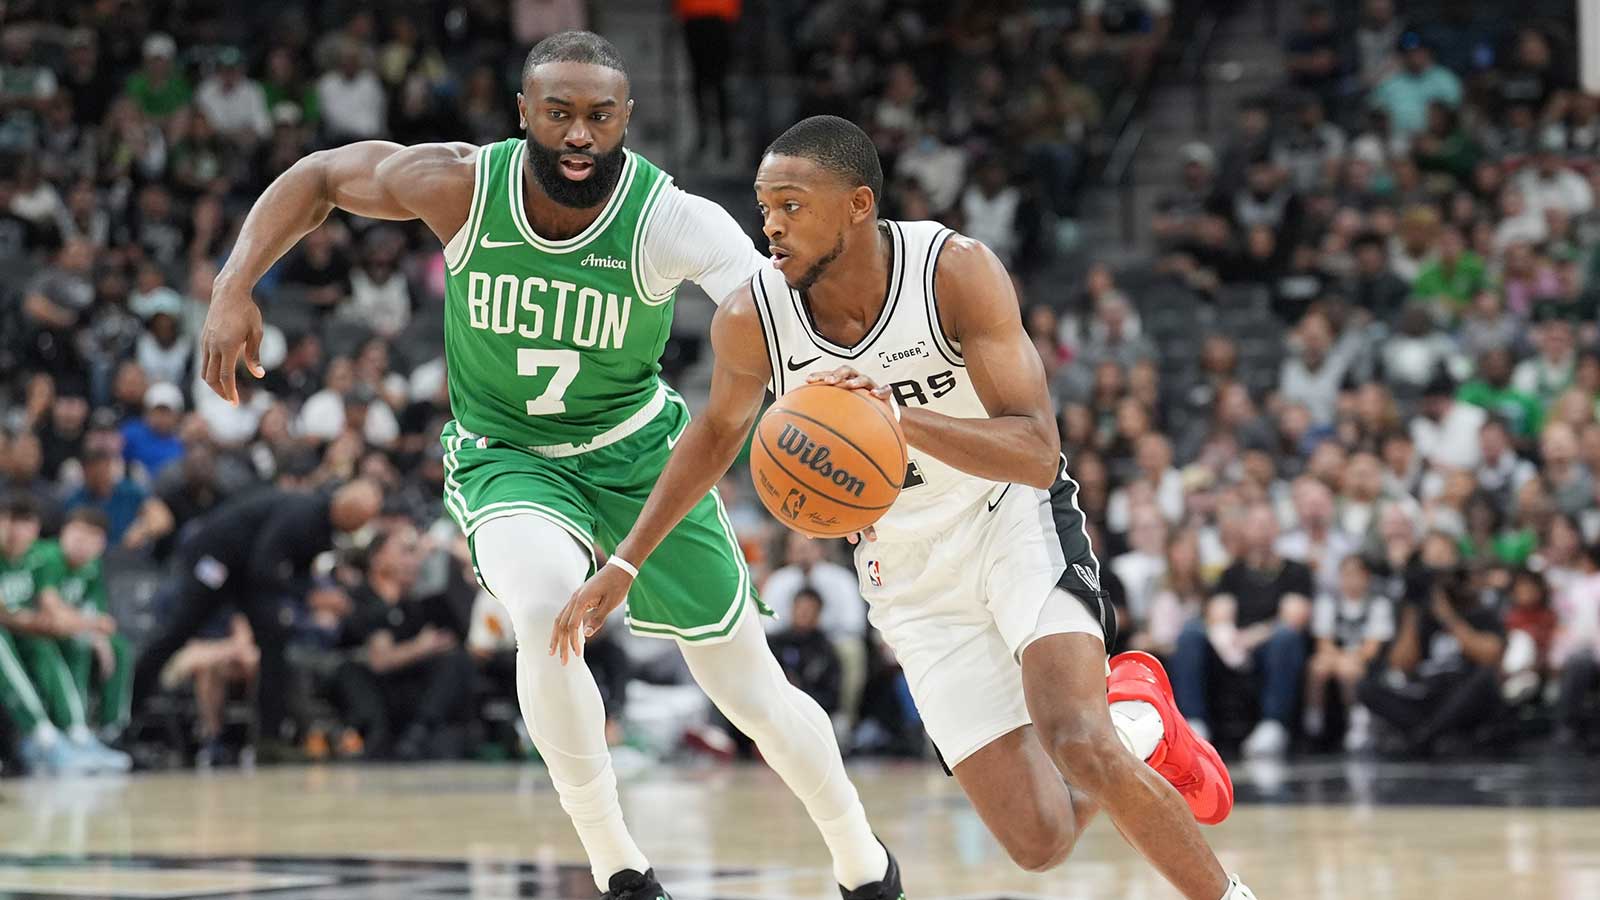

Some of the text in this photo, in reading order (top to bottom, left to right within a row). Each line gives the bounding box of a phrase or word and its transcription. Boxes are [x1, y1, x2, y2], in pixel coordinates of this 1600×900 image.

[580, 253, 627, 270] Amica
[468, 271, 632, 349] BOSTON
[886, 347, 922, 362] LEDGER
[517, 348, 580, 415] 7
[889, 370, 956, 408] RS
[777, 423, 865, 497] Wilson
